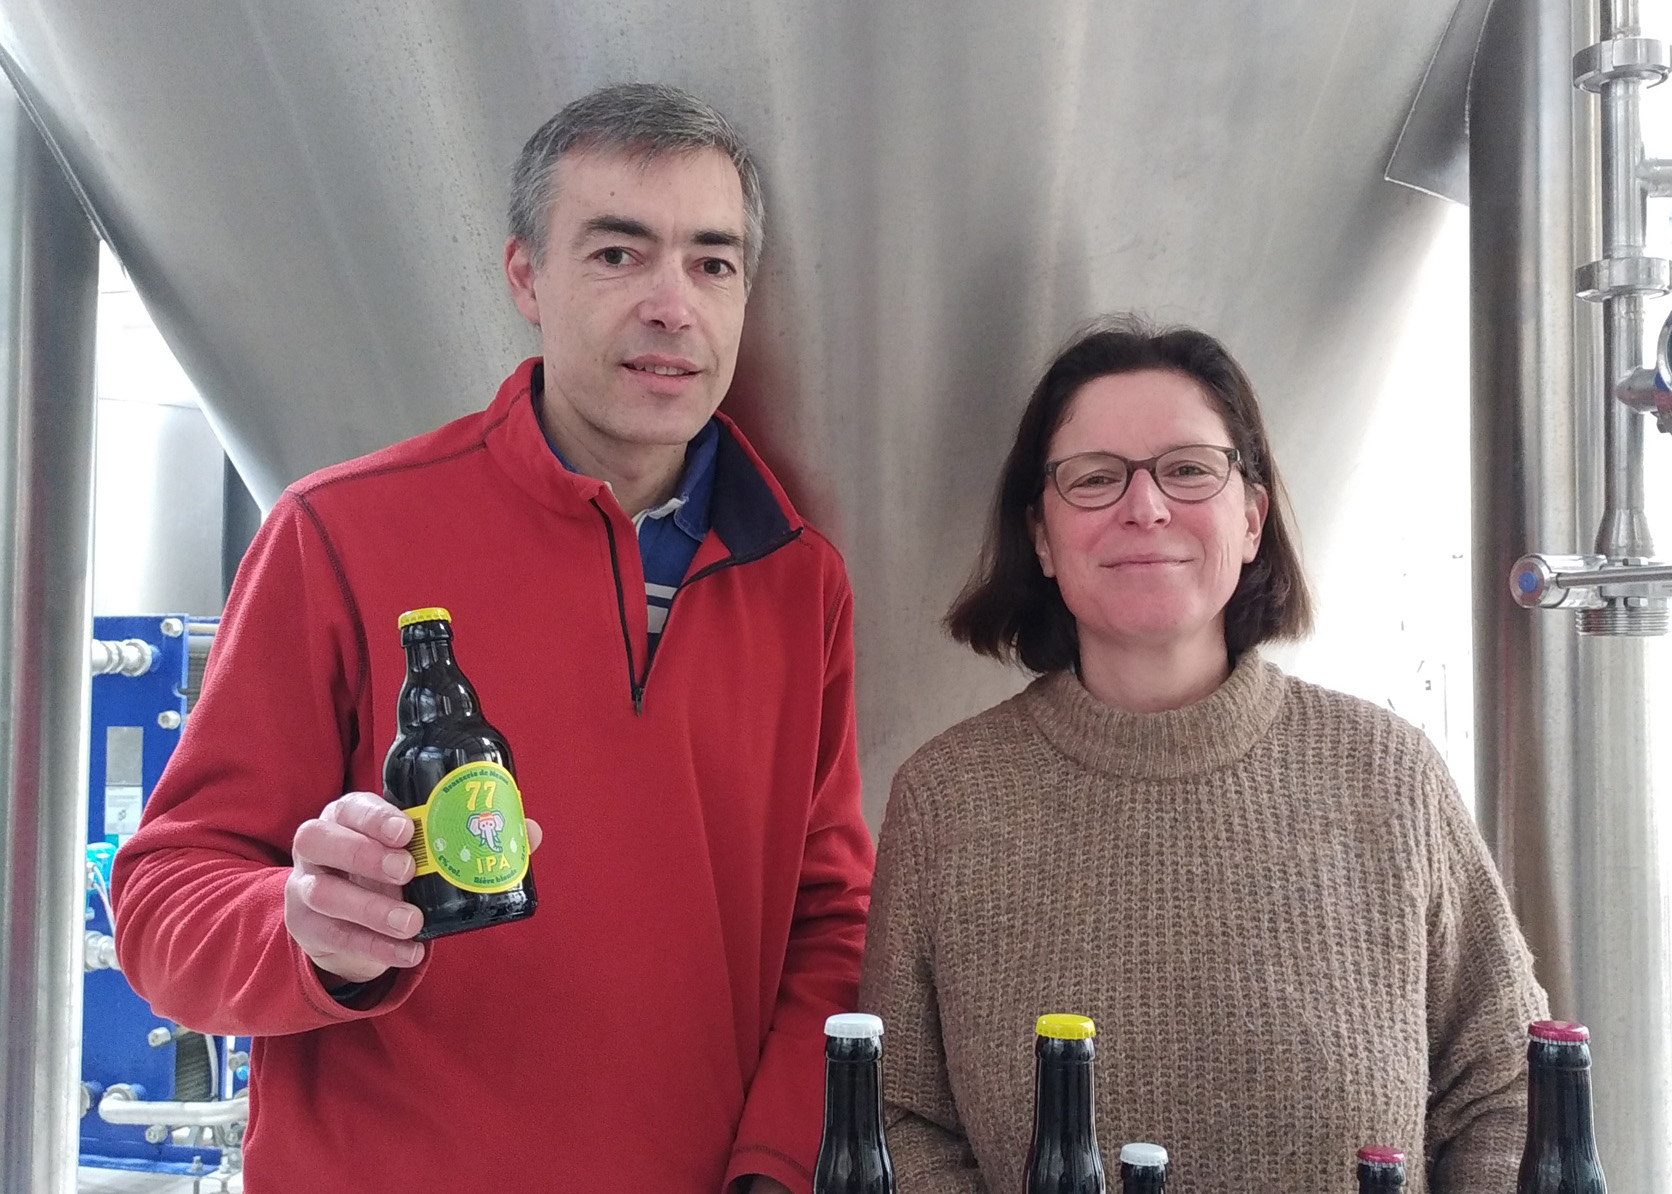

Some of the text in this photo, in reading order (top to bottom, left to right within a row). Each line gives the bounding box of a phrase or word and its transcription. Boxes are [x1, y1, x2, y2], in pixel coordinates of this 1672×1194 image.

[465, 781, 496, 811] 77
[476, 854, 511, 874] IPA
[474, 876, 495, 885] Bière
